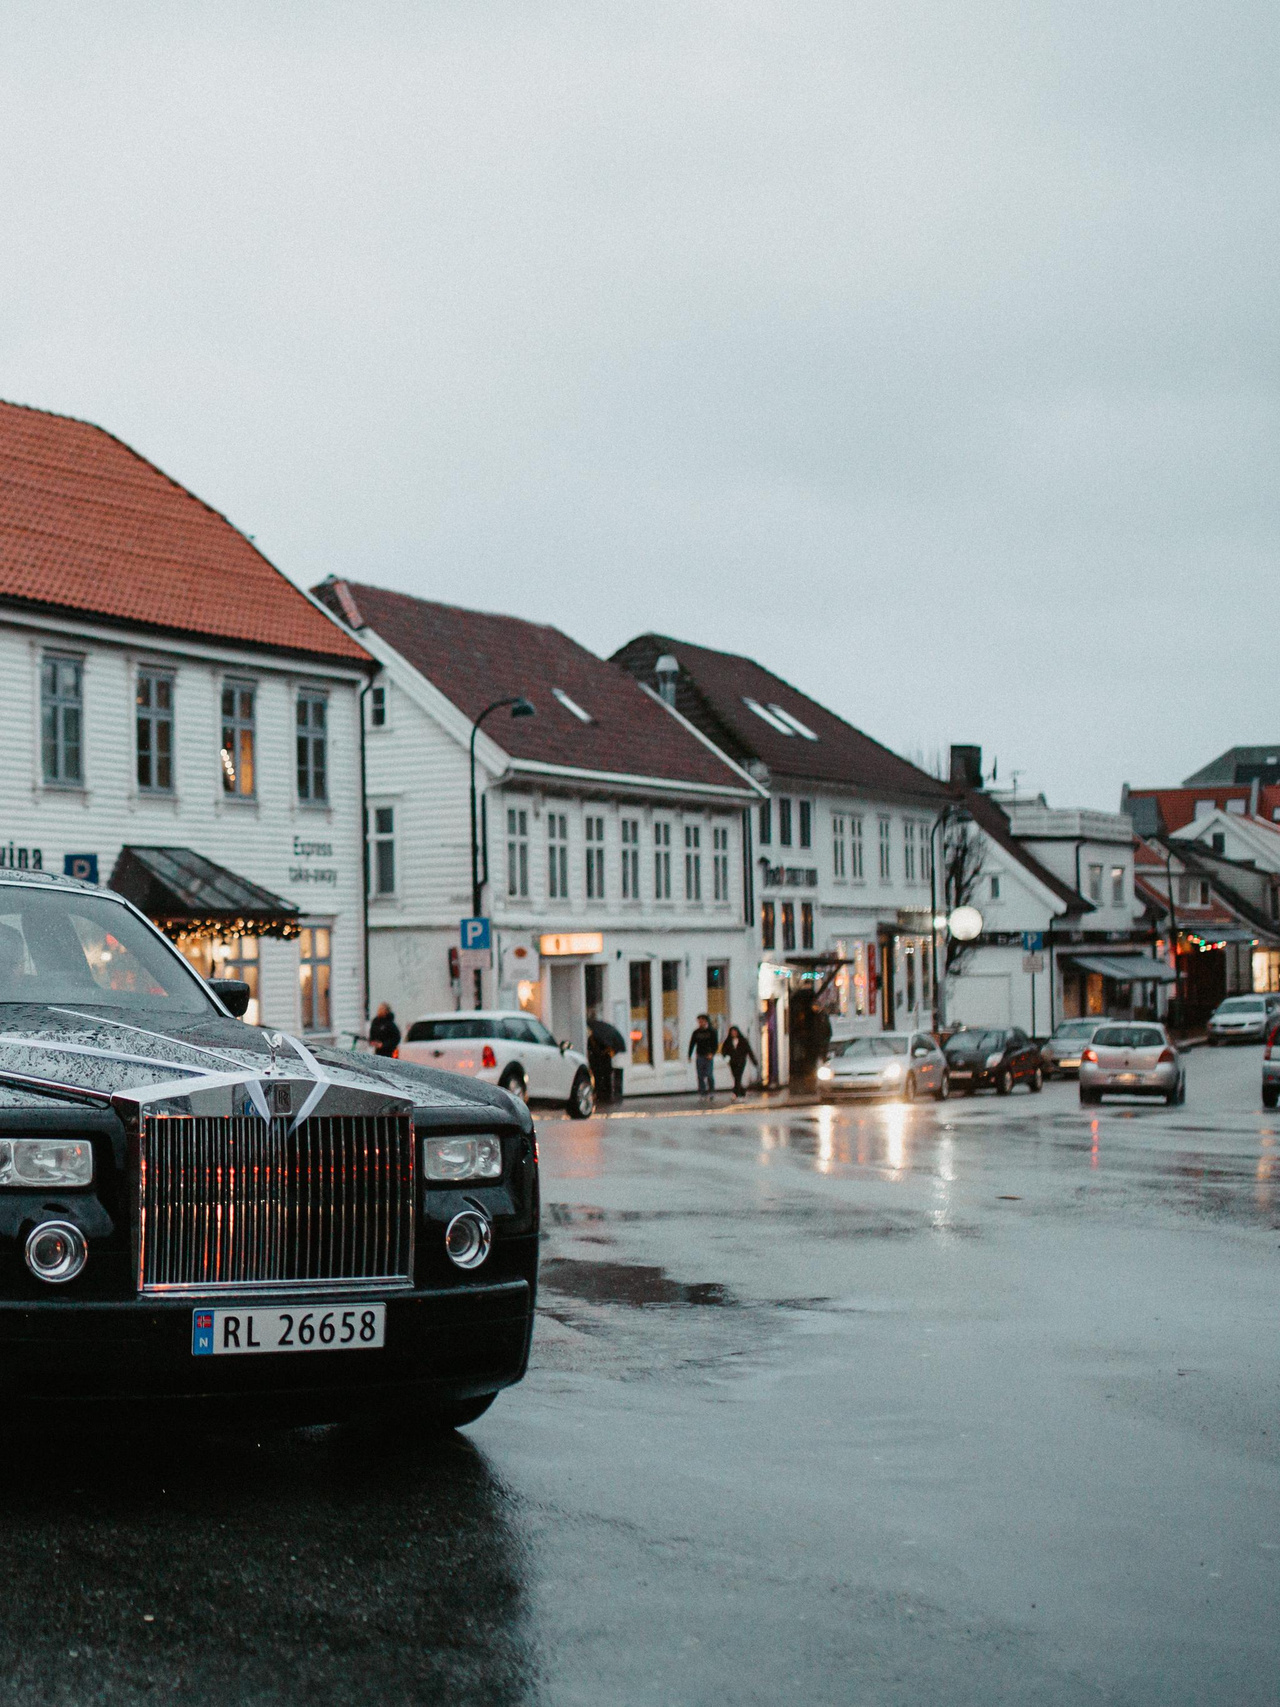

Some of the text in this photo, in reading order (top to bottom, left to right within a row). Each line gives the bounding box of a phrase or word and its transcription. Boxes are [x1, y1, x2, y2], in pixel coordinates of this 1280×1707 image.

[293, 836, 333, 858] Express
[467, 921, 483, 946] P
[1027, 934, 1038, 947] P
[223, 1310, 376, 1348] RL 26658
[199, 1337, 208, 1347] N
